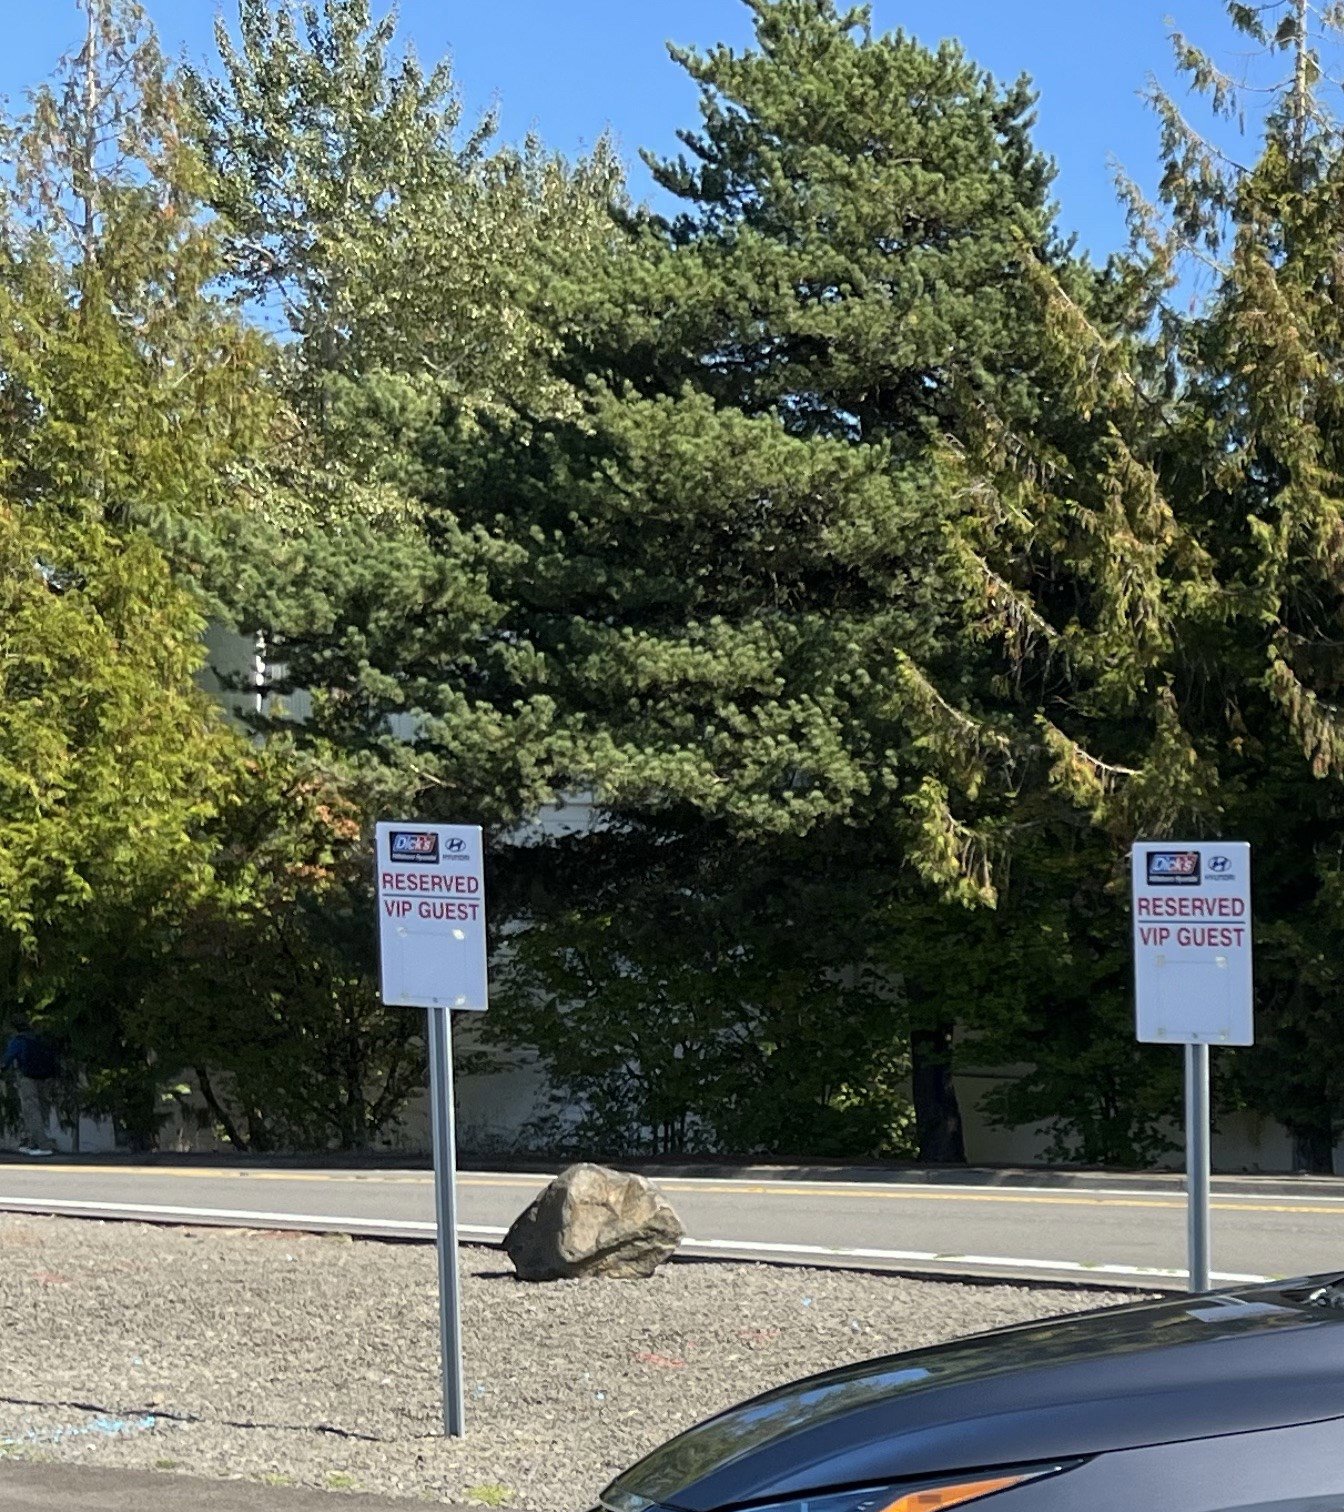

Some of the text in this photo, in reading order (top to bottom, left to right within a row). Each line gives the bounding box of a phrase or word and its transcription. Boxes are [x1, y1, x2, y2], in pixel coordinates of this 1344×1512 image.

[382, 873, 479, 893] RESERVED
[385, 900, 480, 921] VIP GUEST
[1138, 897, 1245, 917] RESERVED
[1140, 927, 1245, 947] VIP GUEST
